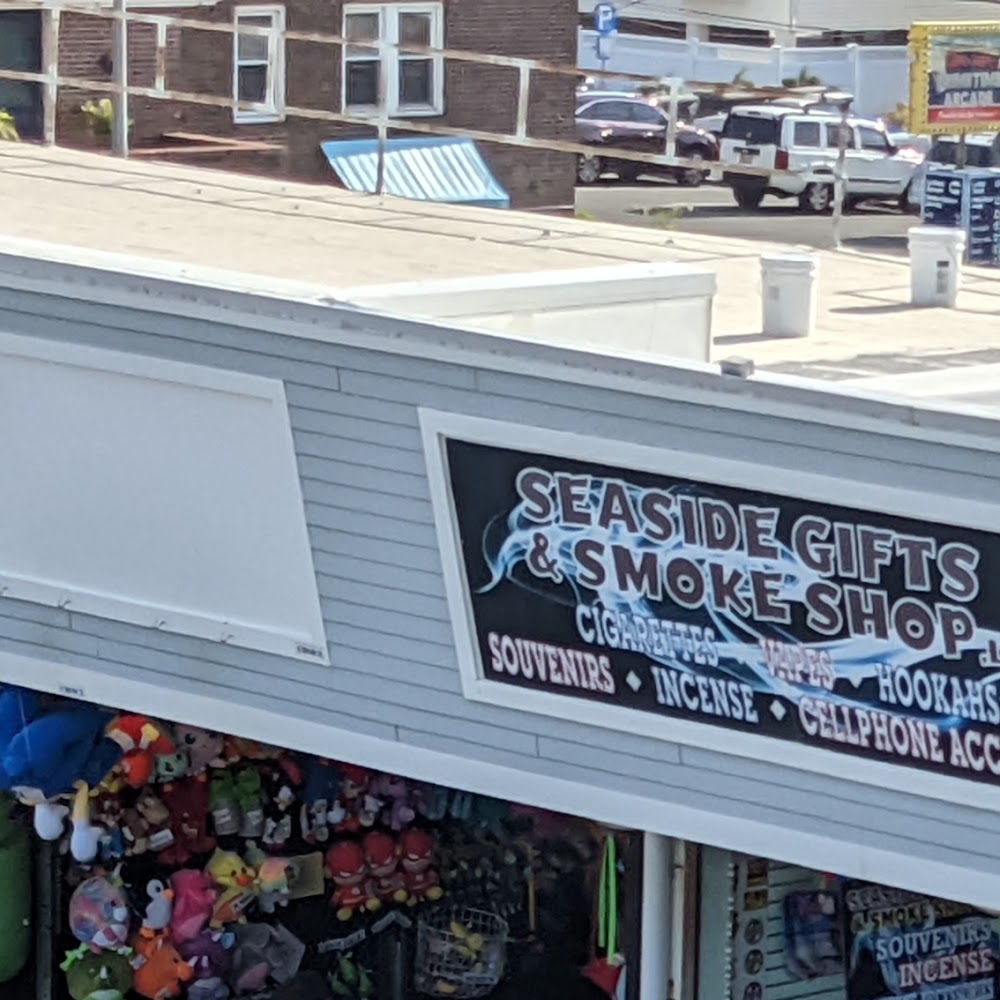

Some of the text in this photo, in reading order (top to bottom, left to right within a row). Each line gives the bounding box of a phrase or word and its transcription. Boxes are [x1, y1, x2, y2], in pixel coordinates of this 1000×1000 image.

[516, 466, 981, 602] SEASIDE GIFTS
[527, 532, 564, 584] &
[573, 537, 792, 625] SMOKE
[805, 581, 978, 660] SHOP
[488, 631, 616, 695] SOUVENIRS
[651, 665, 759, 724] INCENSE
[799, 696, 944, 763] CELLPHONE
[576, 604, 720, 668] CIGARETTES
[875, 662, 1000, 726] HOOKAHS
[876, 921, 992, 962] SOUVENIRS
[898, 948, 995, 989] INCENSE
